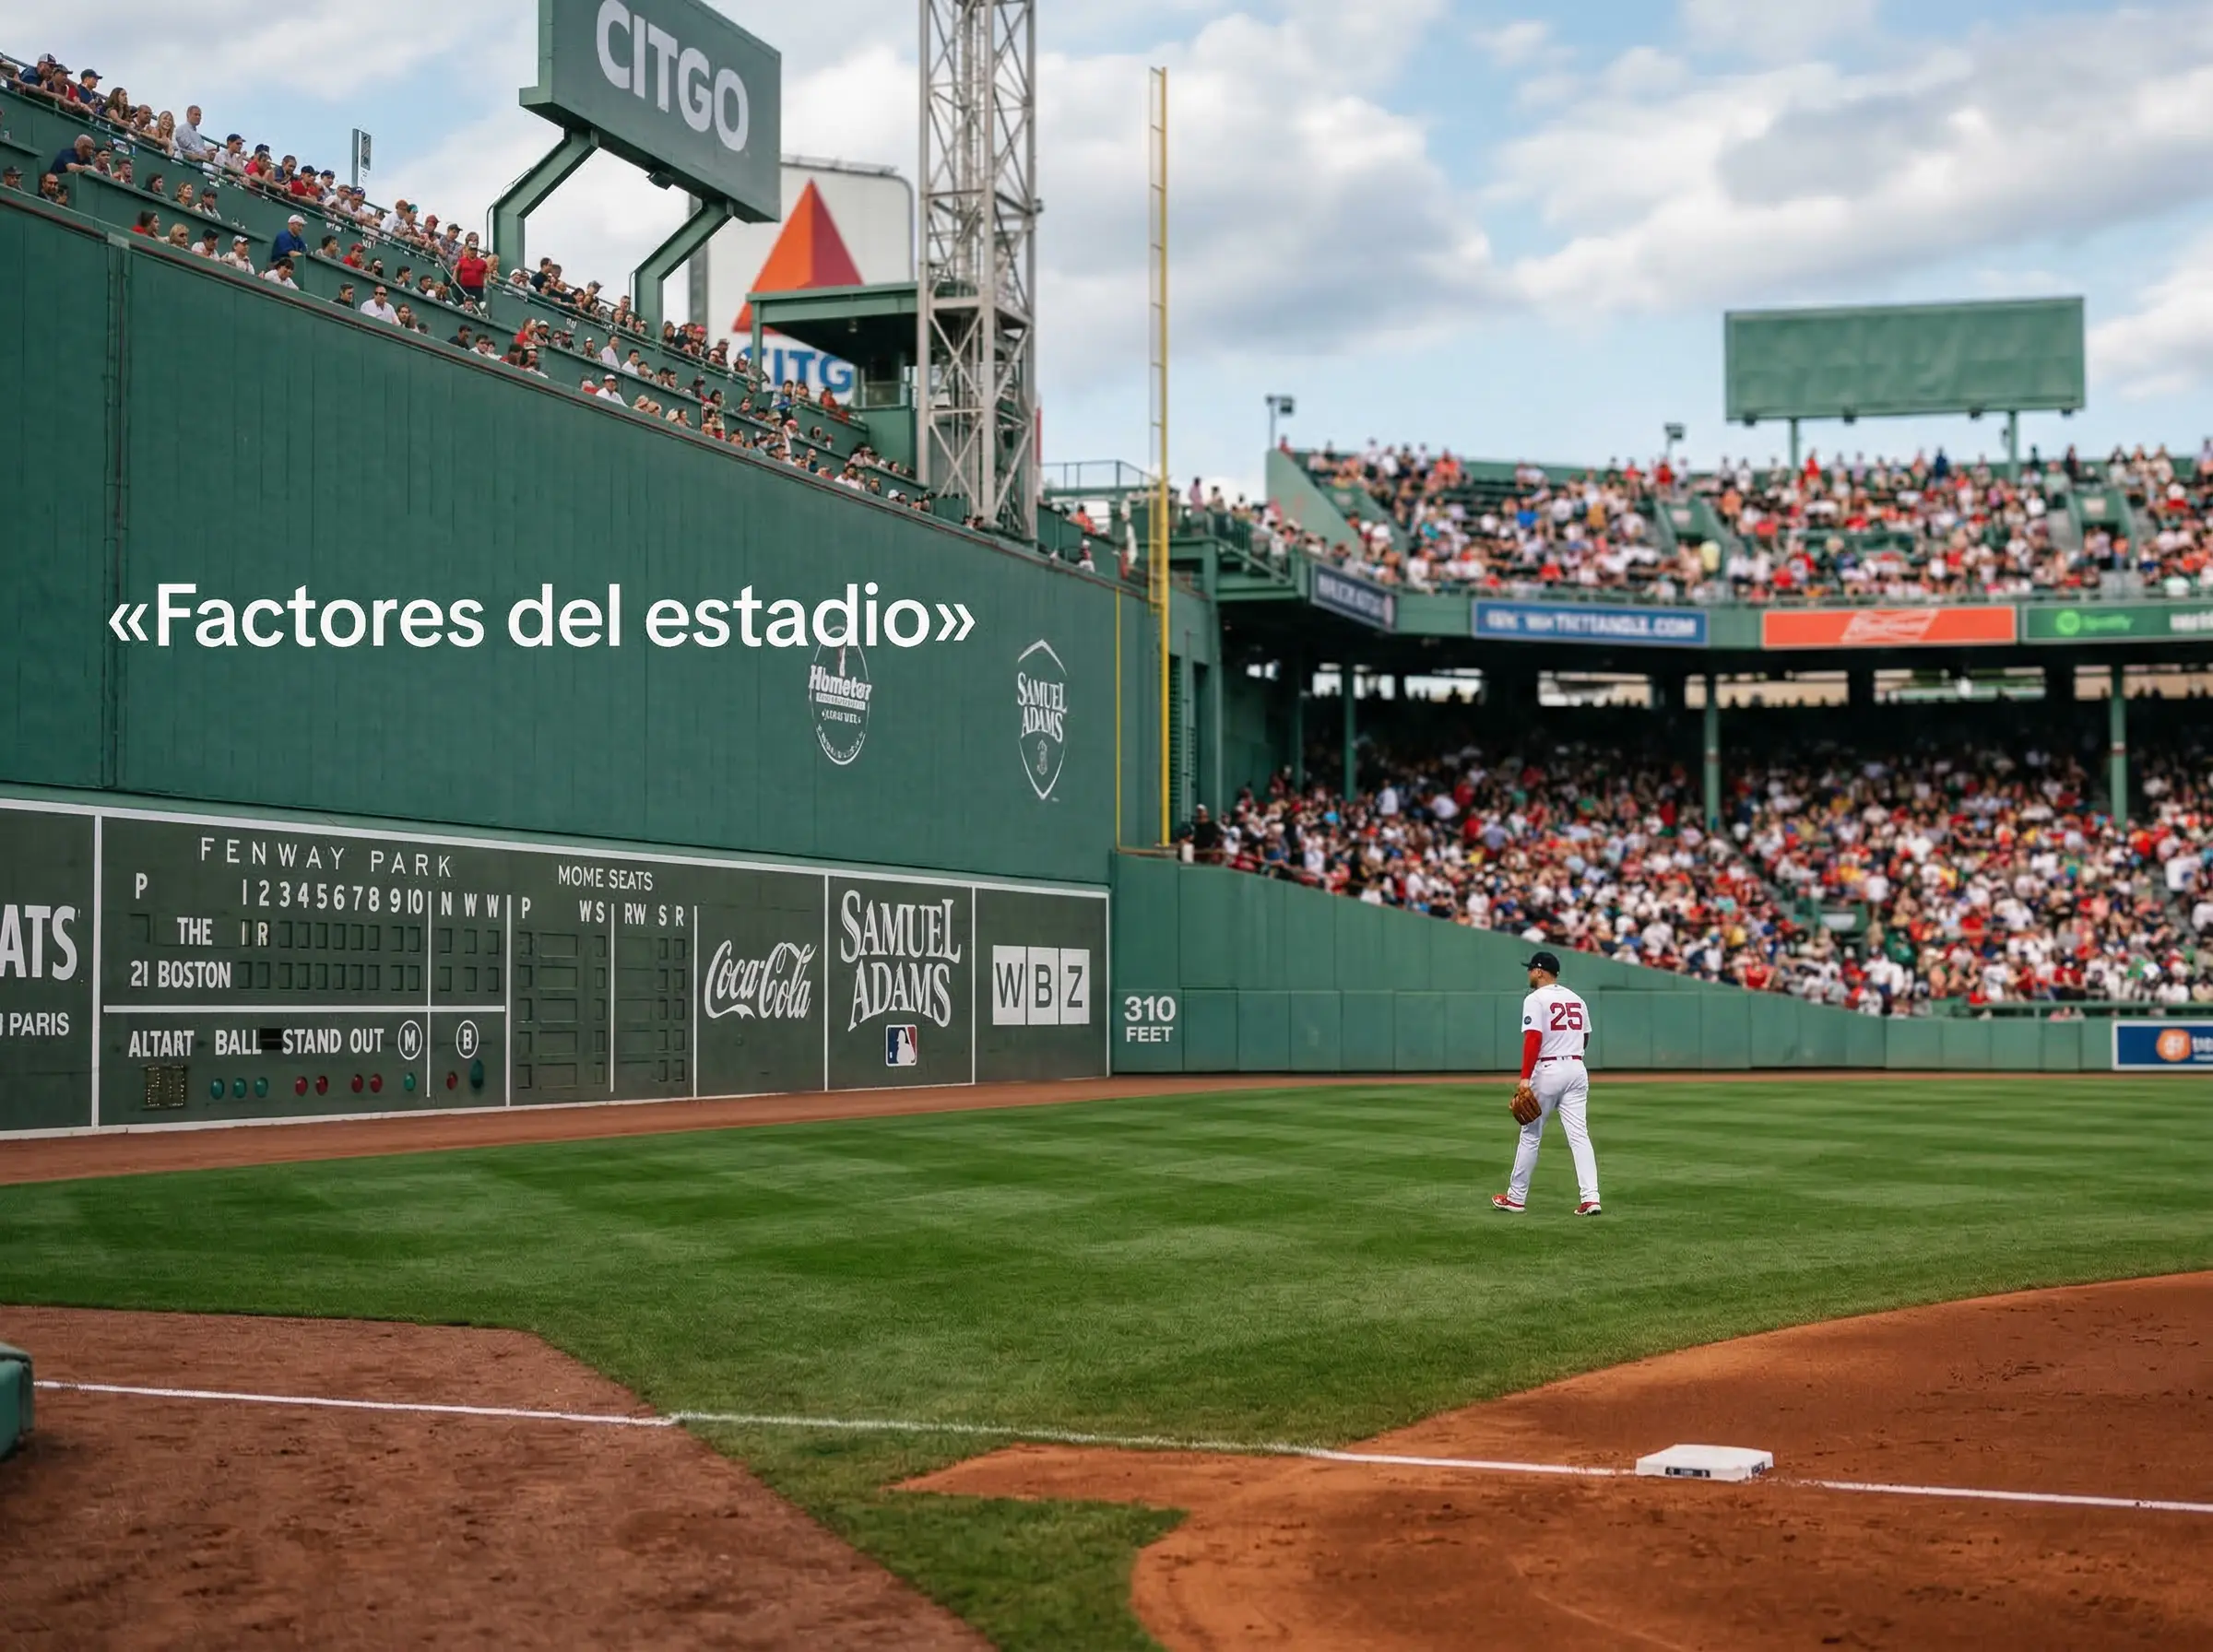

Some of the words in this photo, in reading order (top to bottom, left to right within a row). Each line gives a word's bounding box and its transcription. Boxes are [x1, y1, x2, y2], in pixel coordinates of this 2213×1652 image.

[597, 0, 749, 151] CITGO
[1017, 671, 1068, 714] SAMUEL
[1021, 705, 1063, 743] ADAMS
[201, 836, 345, 870] FENWAY
[371, 850, 452, 877] PARK
[135, 872, 148, 900] P
[558, 865, 604, 888] MOME
[609, 869, 654, 891] SEATS
[521, 897, 531, 919] P
[177, 916, 213, 946] THE
[840, 890, 962, 963] SAMUEL
[158, 960, 231, 988] BOSTON
[704, 939, 817, 1019] Coca-Cola
[847, 959, 952, 1032] ADAMS
[1124, 996, 1176, 1021] 310
[9, 1012, 70, 1036] PARIS
[1549, 1002, 1583, 1031] 25
[128, 1030, 195, 1057] ALTART
[215, 1029, 262, 1056] BALL
[282, 1028, 342, 1055] STAND
[349, 1028, 385, 1054] OUT
[404, 1029, 416, 1052] M
[1126, 1026, 1174, 1042] FEET
